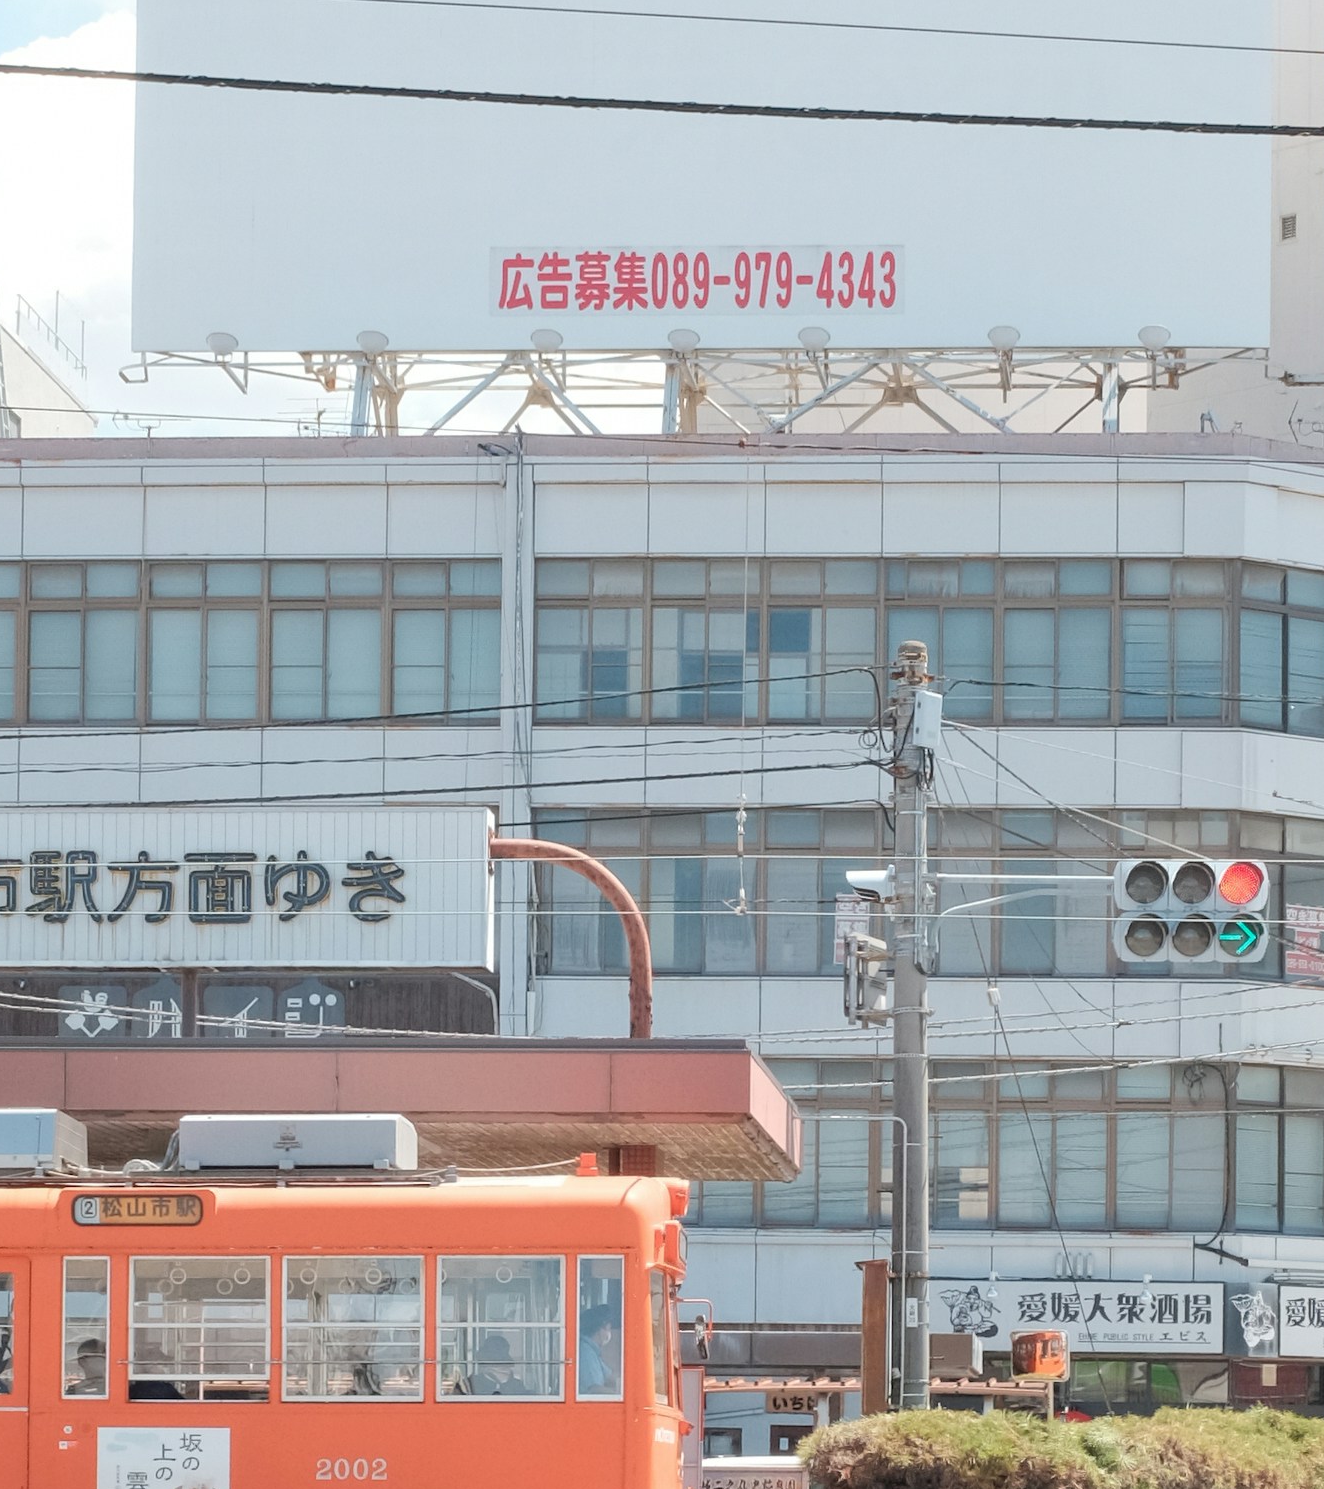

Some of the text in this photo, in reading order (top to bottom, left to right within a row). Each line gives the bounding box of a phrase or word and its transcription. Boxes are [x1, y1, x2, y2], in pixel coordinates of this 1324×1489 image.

[498, 251, 896, 311] 広告募集089-979-4343
[84, 1197, 196, 1218] 2 松山市駅
[1018, 1292, 1212, 1324] 愛媛大衆酒場
[1133, 1333, 1154, 1341] STYLE
[1159, 1331, 1207, 1342] エビス
[153, 1444, 176, 1481] 上の
[180, 1433, 203, 1470] 坂の
[315, 1458, 388, 1481] 2002
